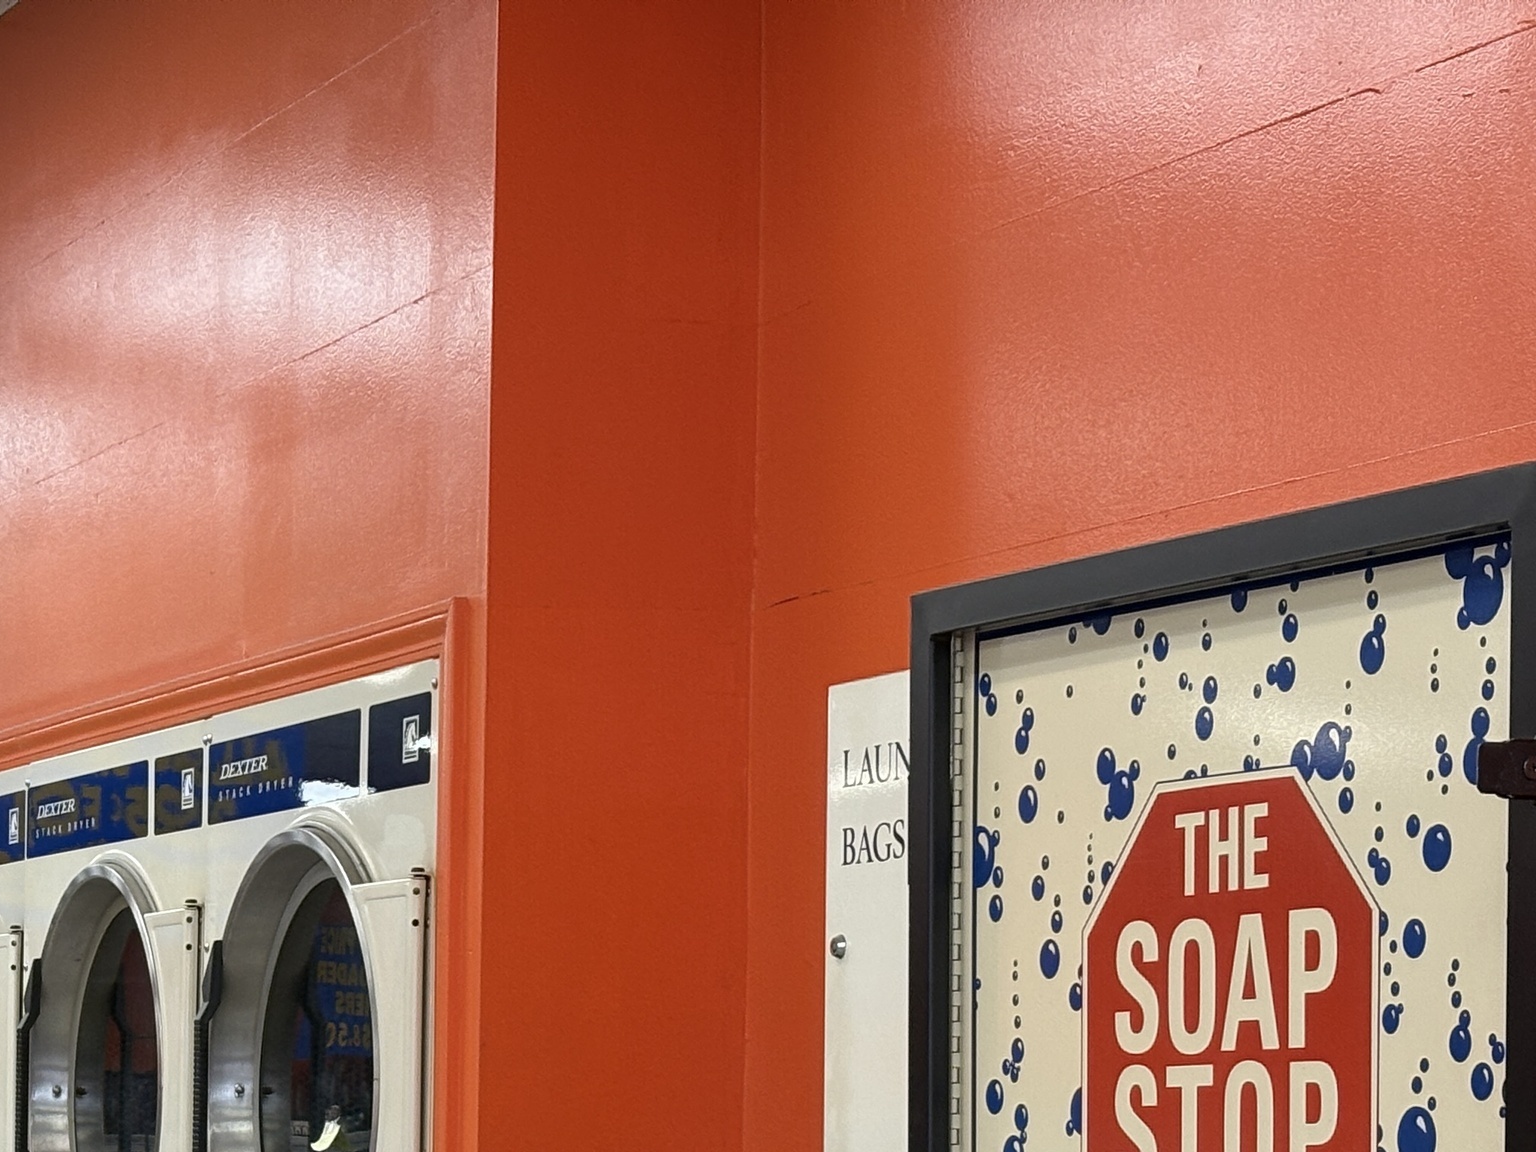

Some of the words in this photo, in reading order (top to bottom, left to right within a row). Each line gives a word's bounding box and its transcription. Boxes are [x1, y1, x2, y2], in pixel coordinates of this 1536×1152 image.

[219, 755, 269, 780] DEXTER
[218, 786, 251, 802] STACK
[258, 776, 293, 794] DRYER
[36, 798, 76, 820] DEXTER
[35, 824, 62, 839] STACK
[67, 816, 95, 832] DRYER
[841, 819, 906, 866] BAGS
[1174, 802, 1270, 897] THE
[1114, 907, 1339, 1055] SOAP
